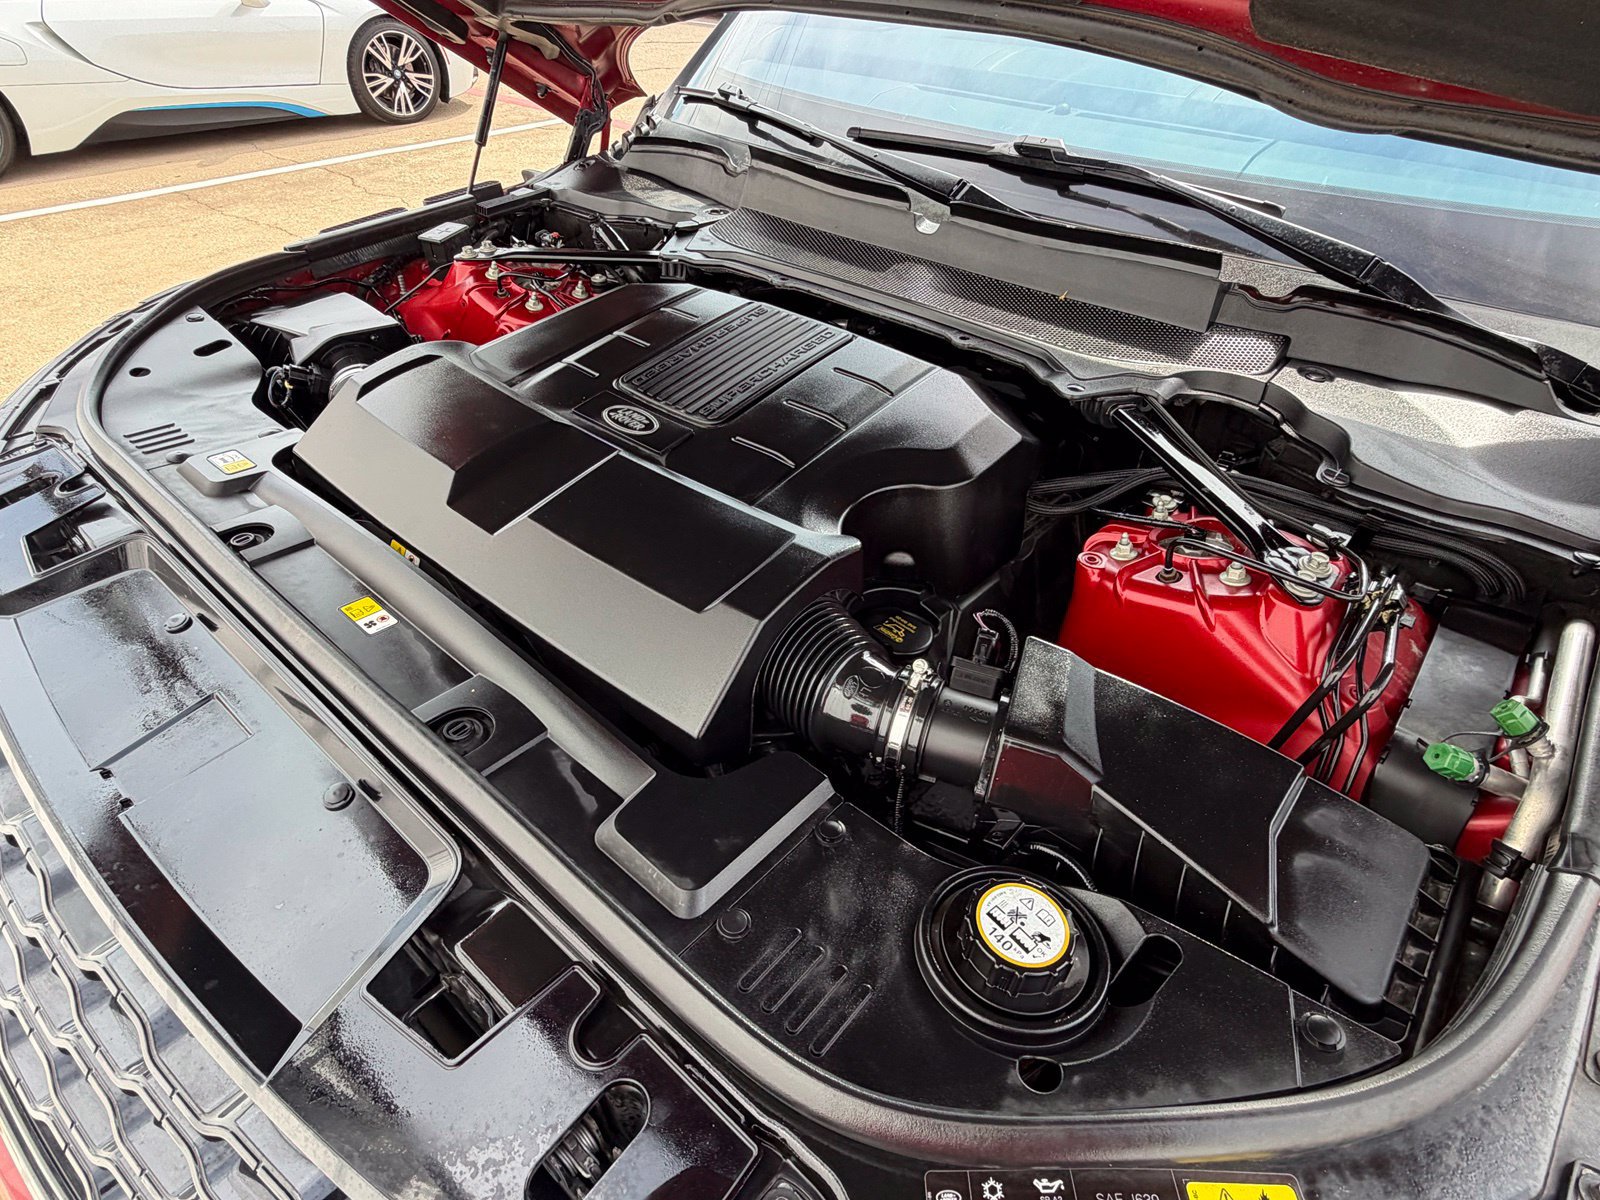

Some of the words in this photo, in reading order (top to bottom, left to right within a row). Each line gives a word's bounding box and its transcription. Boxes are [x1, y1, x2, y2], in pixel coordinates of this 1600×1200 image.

[632, 307, 769, 386] SUPERCHARGED
[698, 330, 837, 416] SUPERCHARGED
[611, 413, 646, 430] ROVER
[617, 408, 646, 420] LAND
[989, 926, 1013, 951] 140
[1036, 947, 1046, 957] OK
